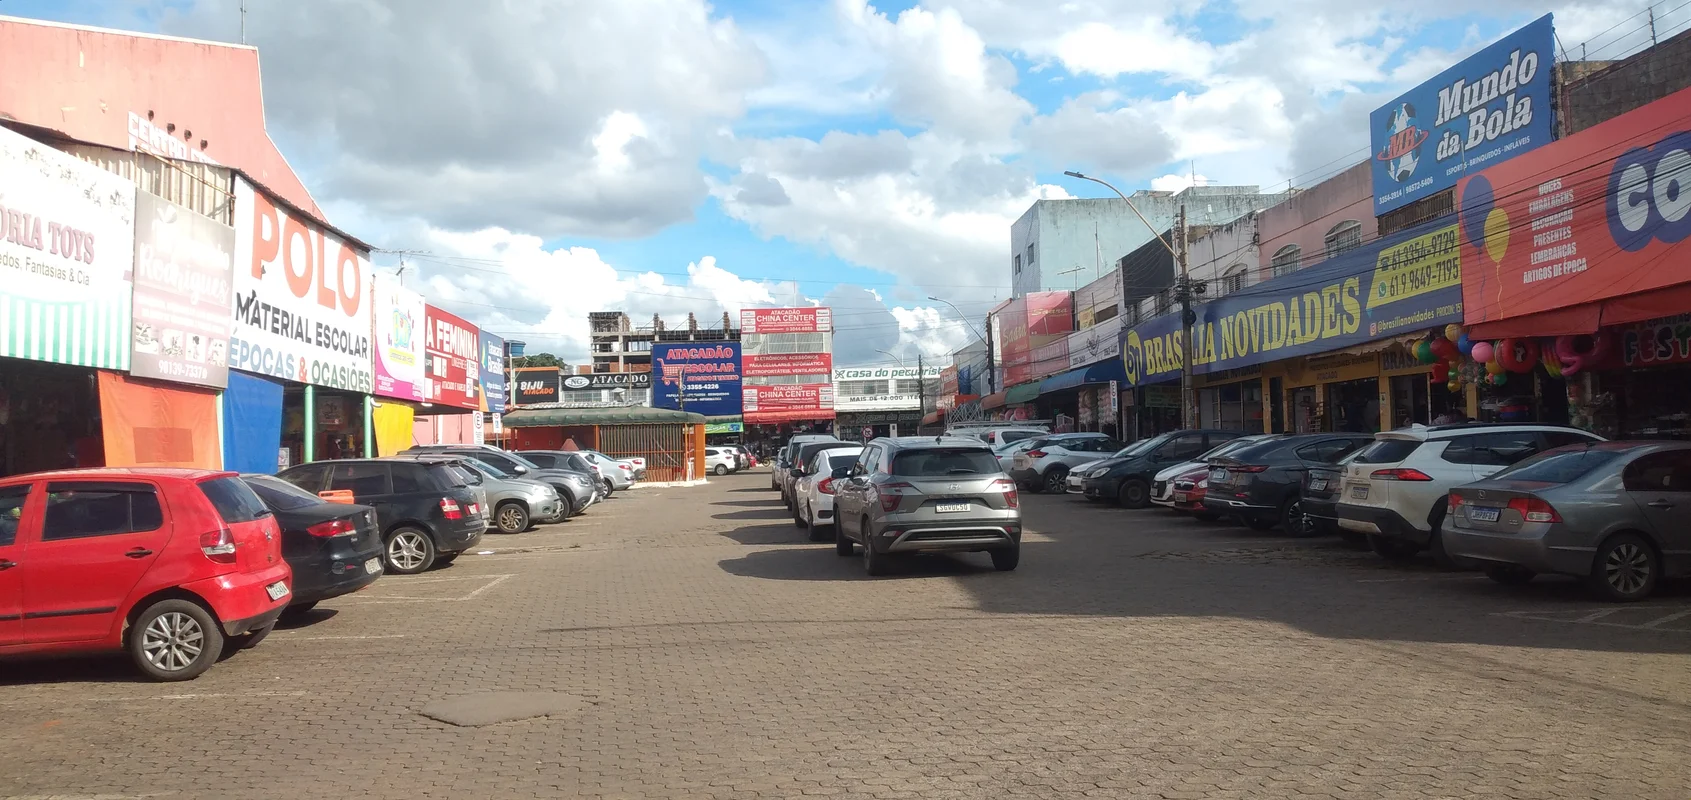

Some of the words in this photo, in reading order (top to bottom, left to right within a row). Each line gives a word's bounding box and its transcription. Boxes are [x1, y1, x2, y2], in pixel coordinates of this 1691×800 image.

[1435, 50, 1538, 126] Mundo
[1436, 132, 1460, 161] da
[1464, 93, 1533, 151] Bola
[1469, 147, 1502, 167] BRINQUEDOS
[48, 221, 95, 265] TOYS
[1533, 226, 1572, 247] PRESENTES
[251, 189, 361, 317] POLO
[26, 256, 67, 280] Fantasias
[69, 267, 75, 282] &
[77, 270, 90, 286] Cia
[1390, 274, 1399, 296] 61
[1401, 273, 1406, 294] 9
[1409, 256, 1459, 291] 9649-7195
[1523, 266, 1552, 284] ARTIGOS
[1553, 264, 1562, 278] DE
[1563, 257, 1588, 275] ÉPOCA
[236, 291, 312, 344] MATERIAL
[315, 321, 368, 359] ESCOLAR
[1219, 276, 1361, 361] NOVIDADES
[436, 319, 478, 361] FEMININA
[666, 345, 734, 359] ATACADÃO
[229, 329, 295, 381] ÉPOCAS
[298, 356, 308, 383] &
[311, 360, 370, 393] OCASIÕES
[684, 362, 735, 373] ESCOLAR
[846, 369, 872, 378] casa
[875, 368, 888, 377] do
[520, 381, 544, 390] BIJU
[523, 387, 555, 395] ATACADO
[592, 374, 648, 384] ATACADO
[785, 390, 817, 398] CENTER
